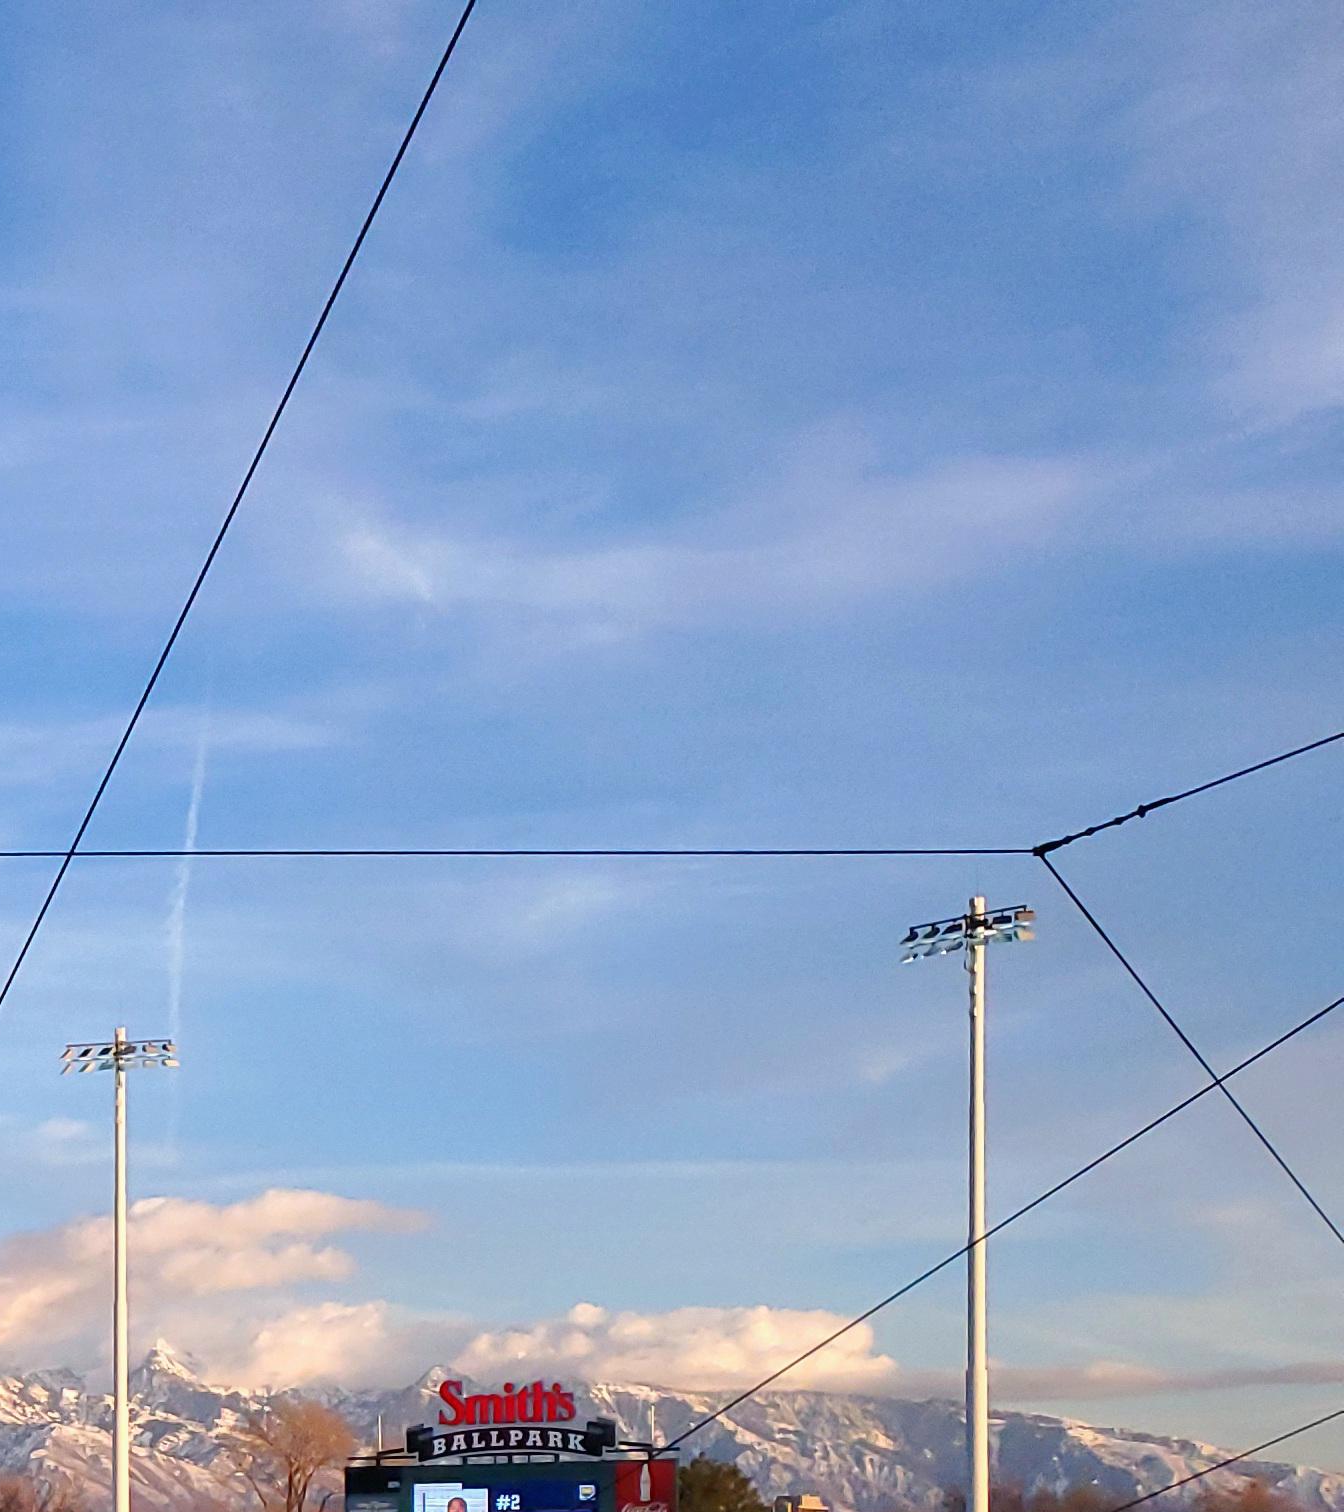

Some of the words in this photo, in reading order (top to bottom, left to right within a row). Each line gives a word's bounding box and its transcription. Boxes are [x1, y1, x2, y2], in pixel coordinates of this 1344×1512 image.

[439, 1380, 577, 1425] Smith's
[432, 1430, 588, 1456] BALLPARK
[496, 1495, 520, 1511] #2
